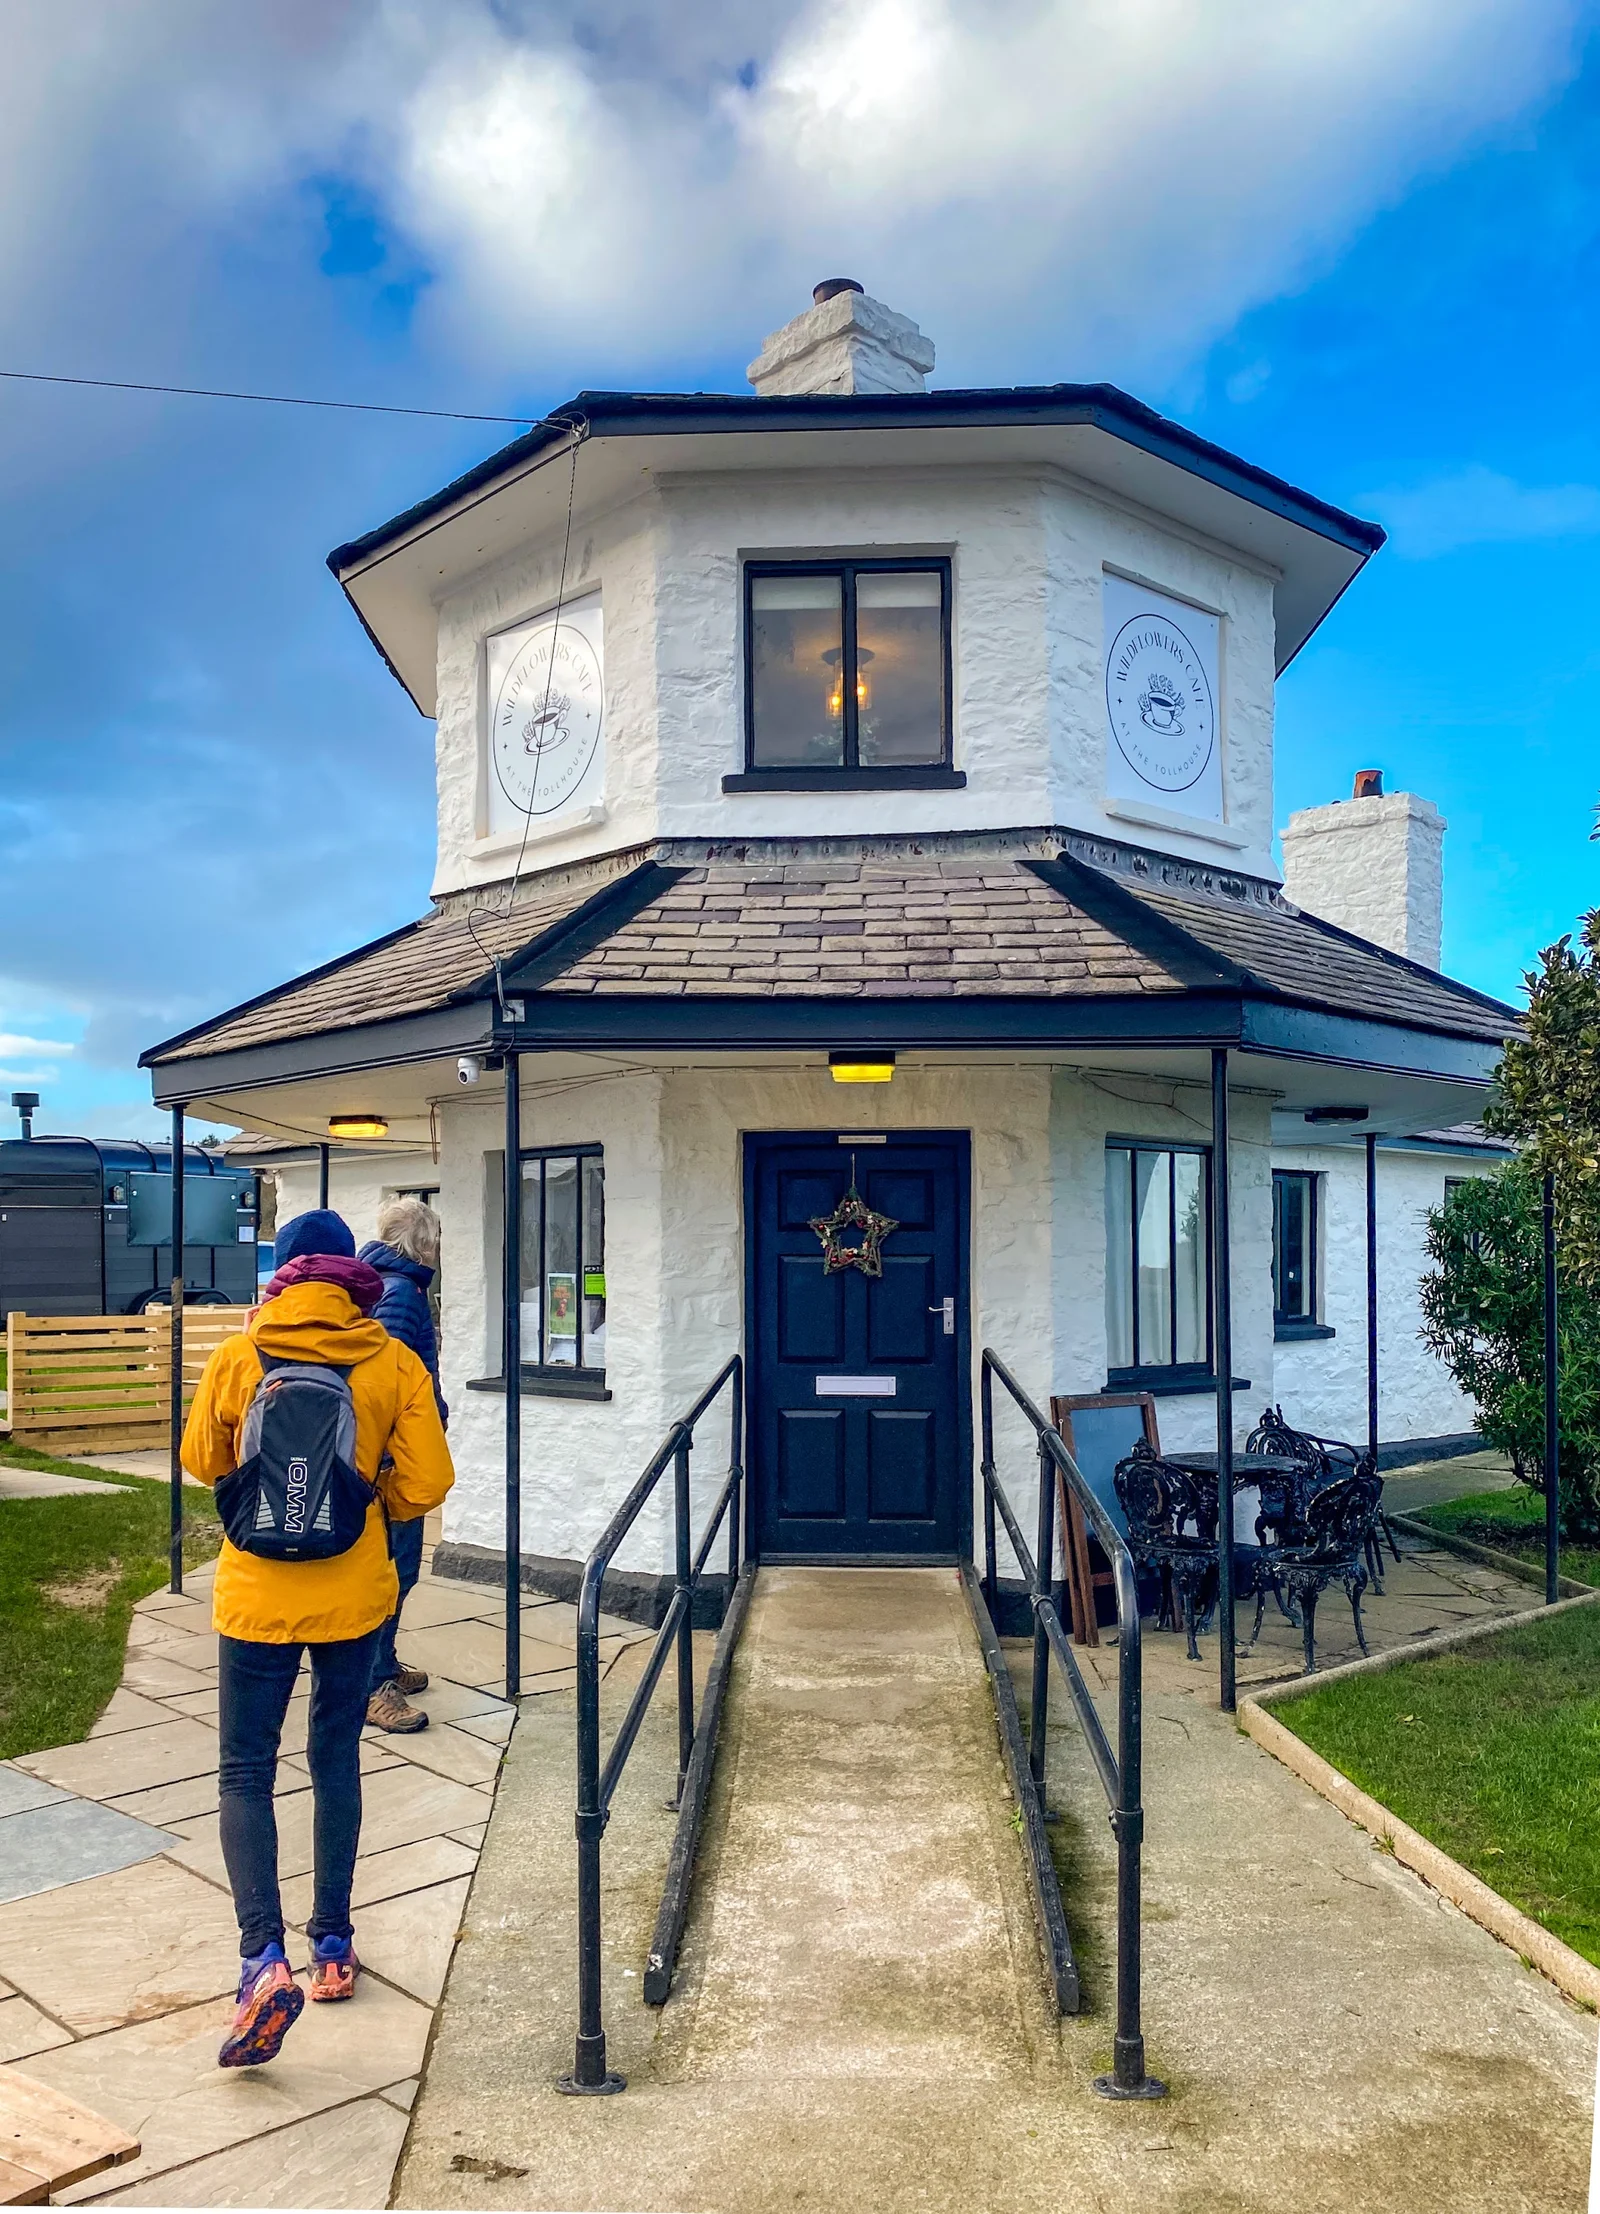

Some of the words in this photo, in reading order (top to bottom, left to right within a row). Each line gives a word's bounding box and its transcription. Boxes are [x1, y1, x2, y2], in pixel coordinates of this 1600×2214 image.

[1116, 631, 1185, 682] WILDFLOWERS
[506, 765, 516, 779] AT
[517, 781, 532, 797] THE
[537, 738, 588, 797] TOLLHOUSE
[1121, 722, 1130, 737] AT
[1132, 744, 1149, 765] THE
[1155, 744, 1202, 776] TOLLHOUSE
[284, 1462, 308, 1533] OMM
